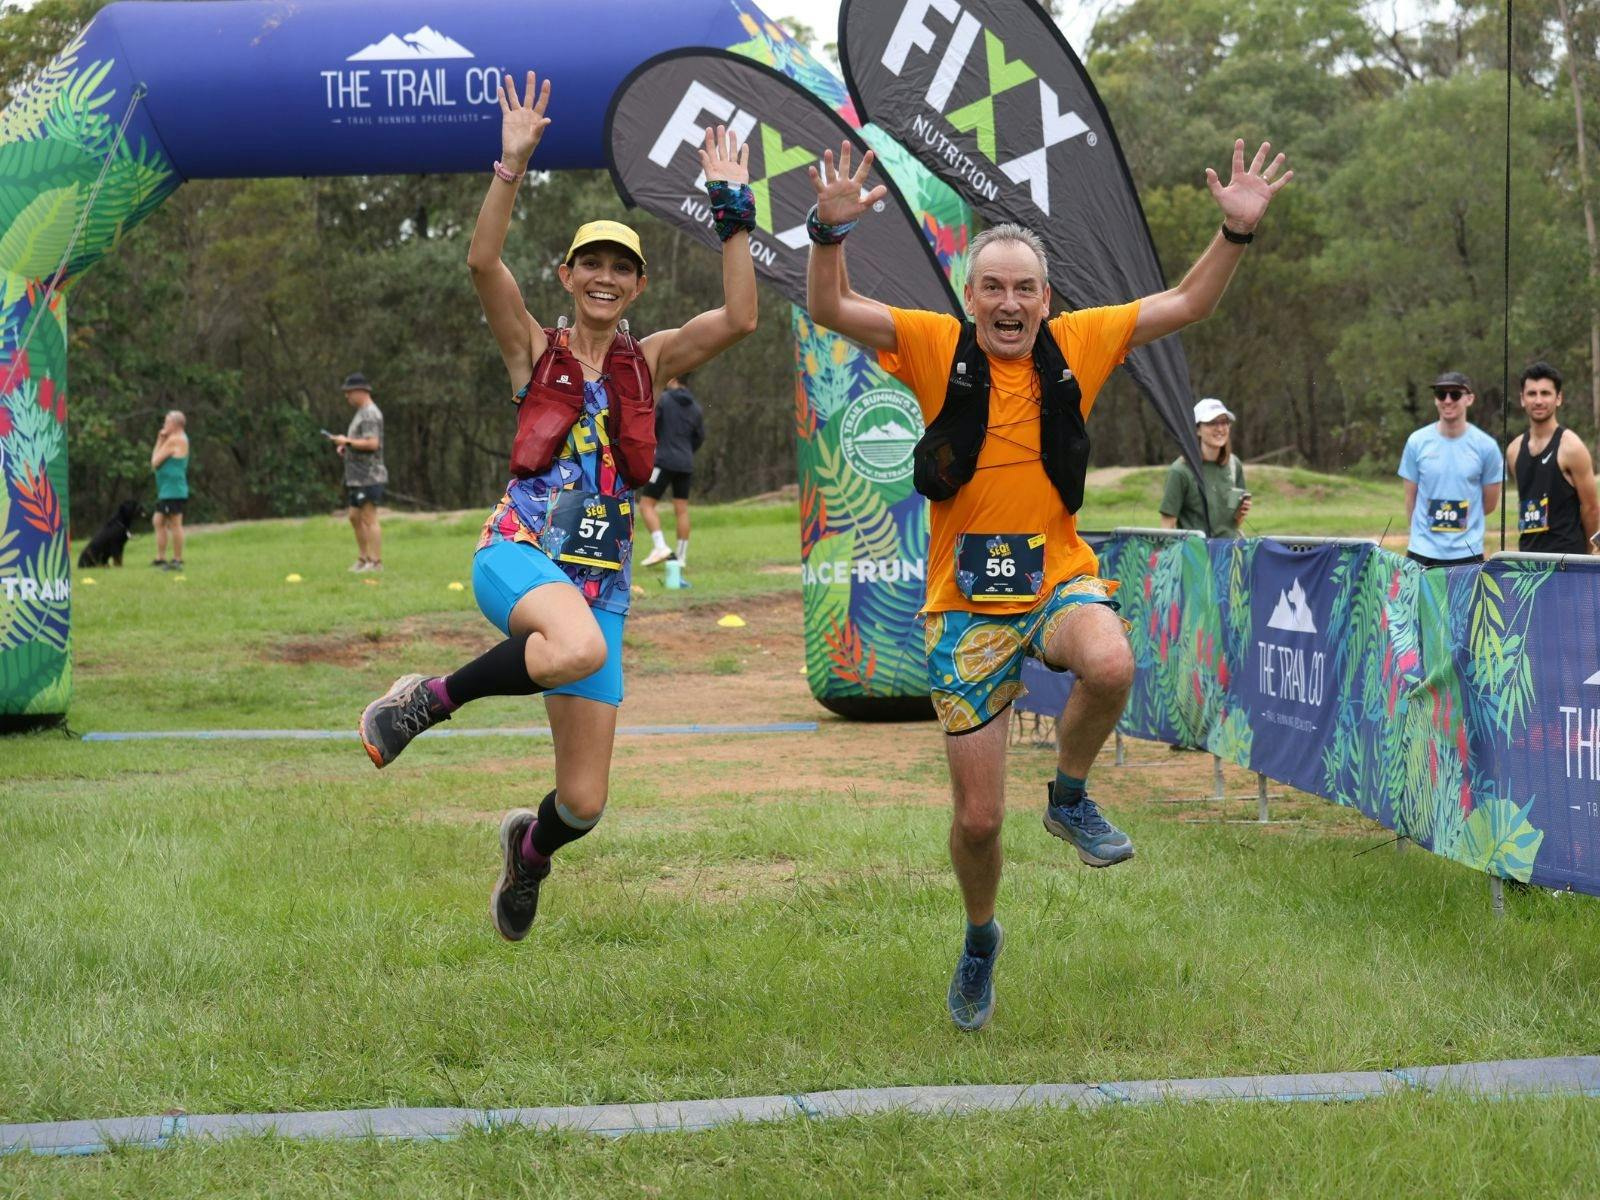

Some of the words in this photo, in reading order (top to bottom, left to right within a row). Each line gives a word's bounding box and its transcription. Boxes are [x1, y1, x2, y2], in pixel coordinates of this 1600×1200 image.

[320, 70, 371, 108] THE
[380, 68, 456, 107] TRAIL
[465, 66, 501, 104] CO
[912, 114, 999, 201] NUTRITION
[578, 518, 610, 540] 57
[985, 558, 1016, 577] 56
[0, 577, 69, 601] TRAIN
[1258, 641, 1277, 697] THE
[1277, 646, 1306, 703] TRAIL
[1308, 651, 1324, 707] CO
